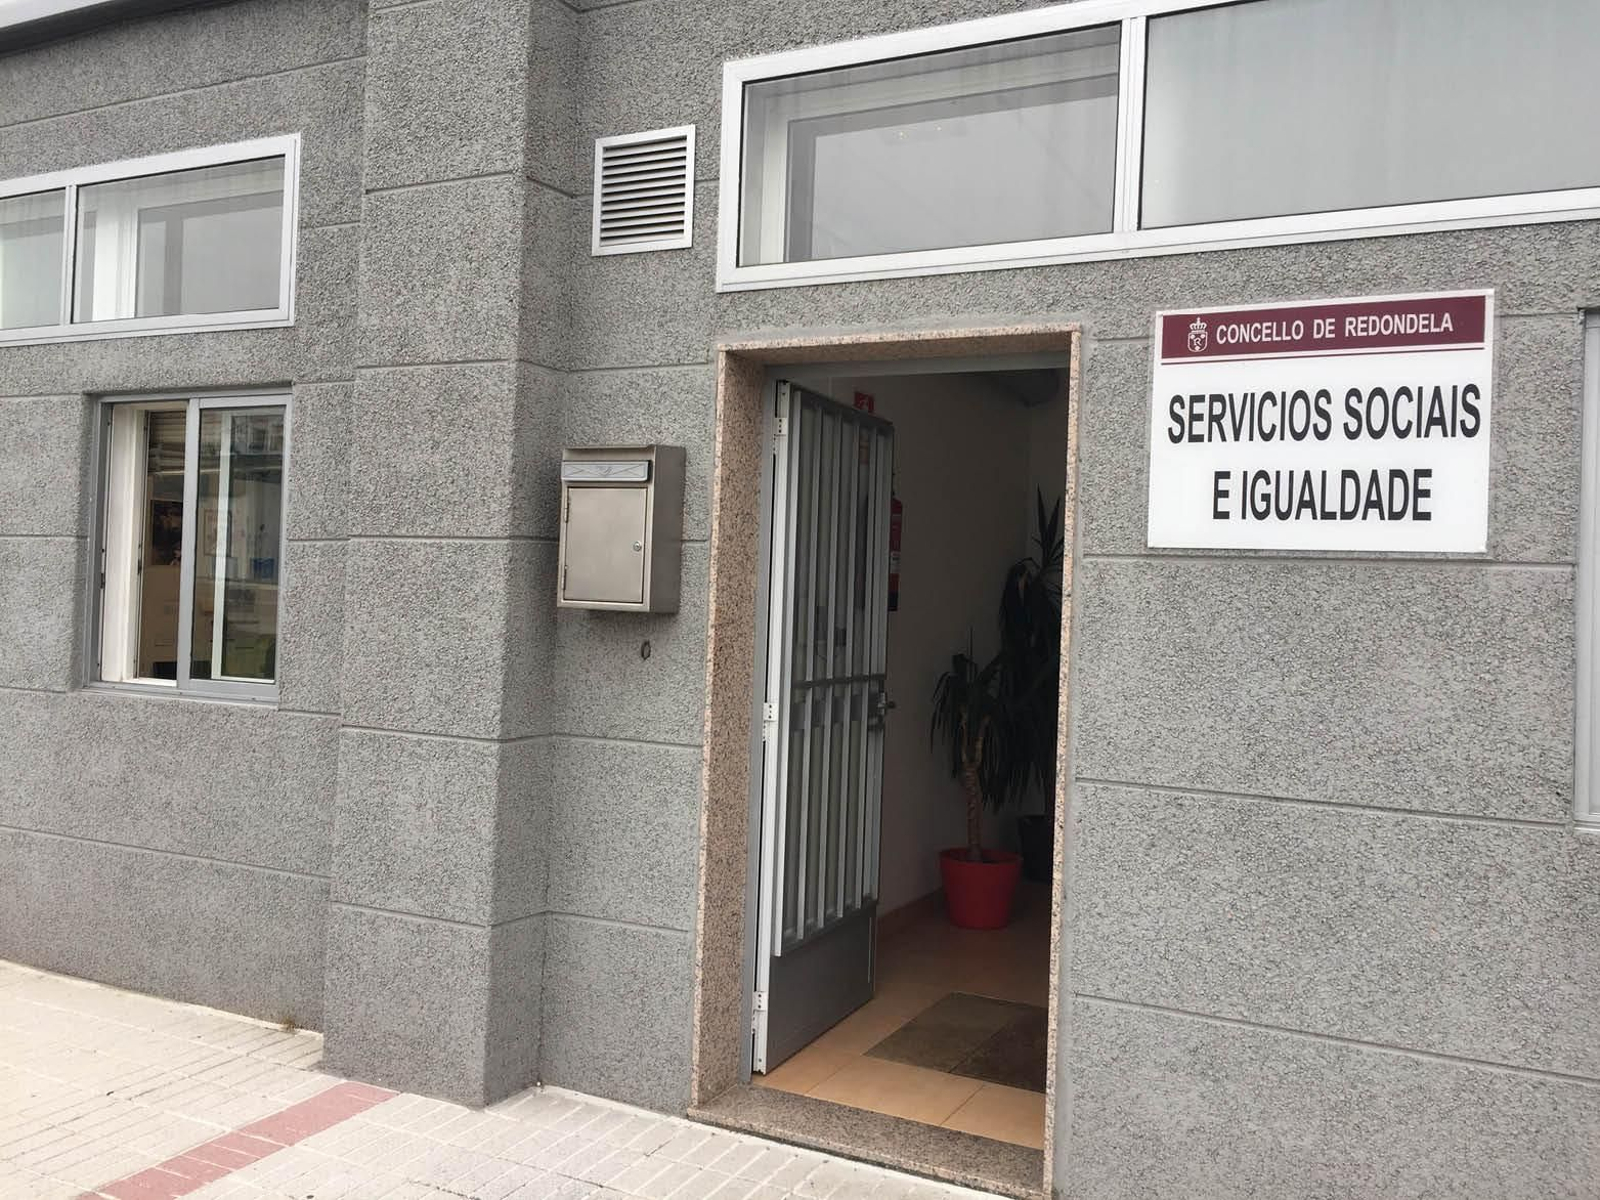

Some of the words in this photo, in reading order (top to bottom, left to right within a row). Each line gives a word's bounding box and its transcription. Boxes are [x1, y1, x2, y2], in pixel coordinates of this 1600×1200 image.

[1216, 319, 1304, 345] CONCELLO
[1313, 318, 1336, 339] DE
[1345, 312, 1454, 337] REDONDELA
[1168, 389, 1332, 443] SERVICIOS
[1343, 383, 1481, 441] SOCIAIS
[1212, 470, 1231, 520] E
[1241, 468, 1433, 521] IGUALDADE
